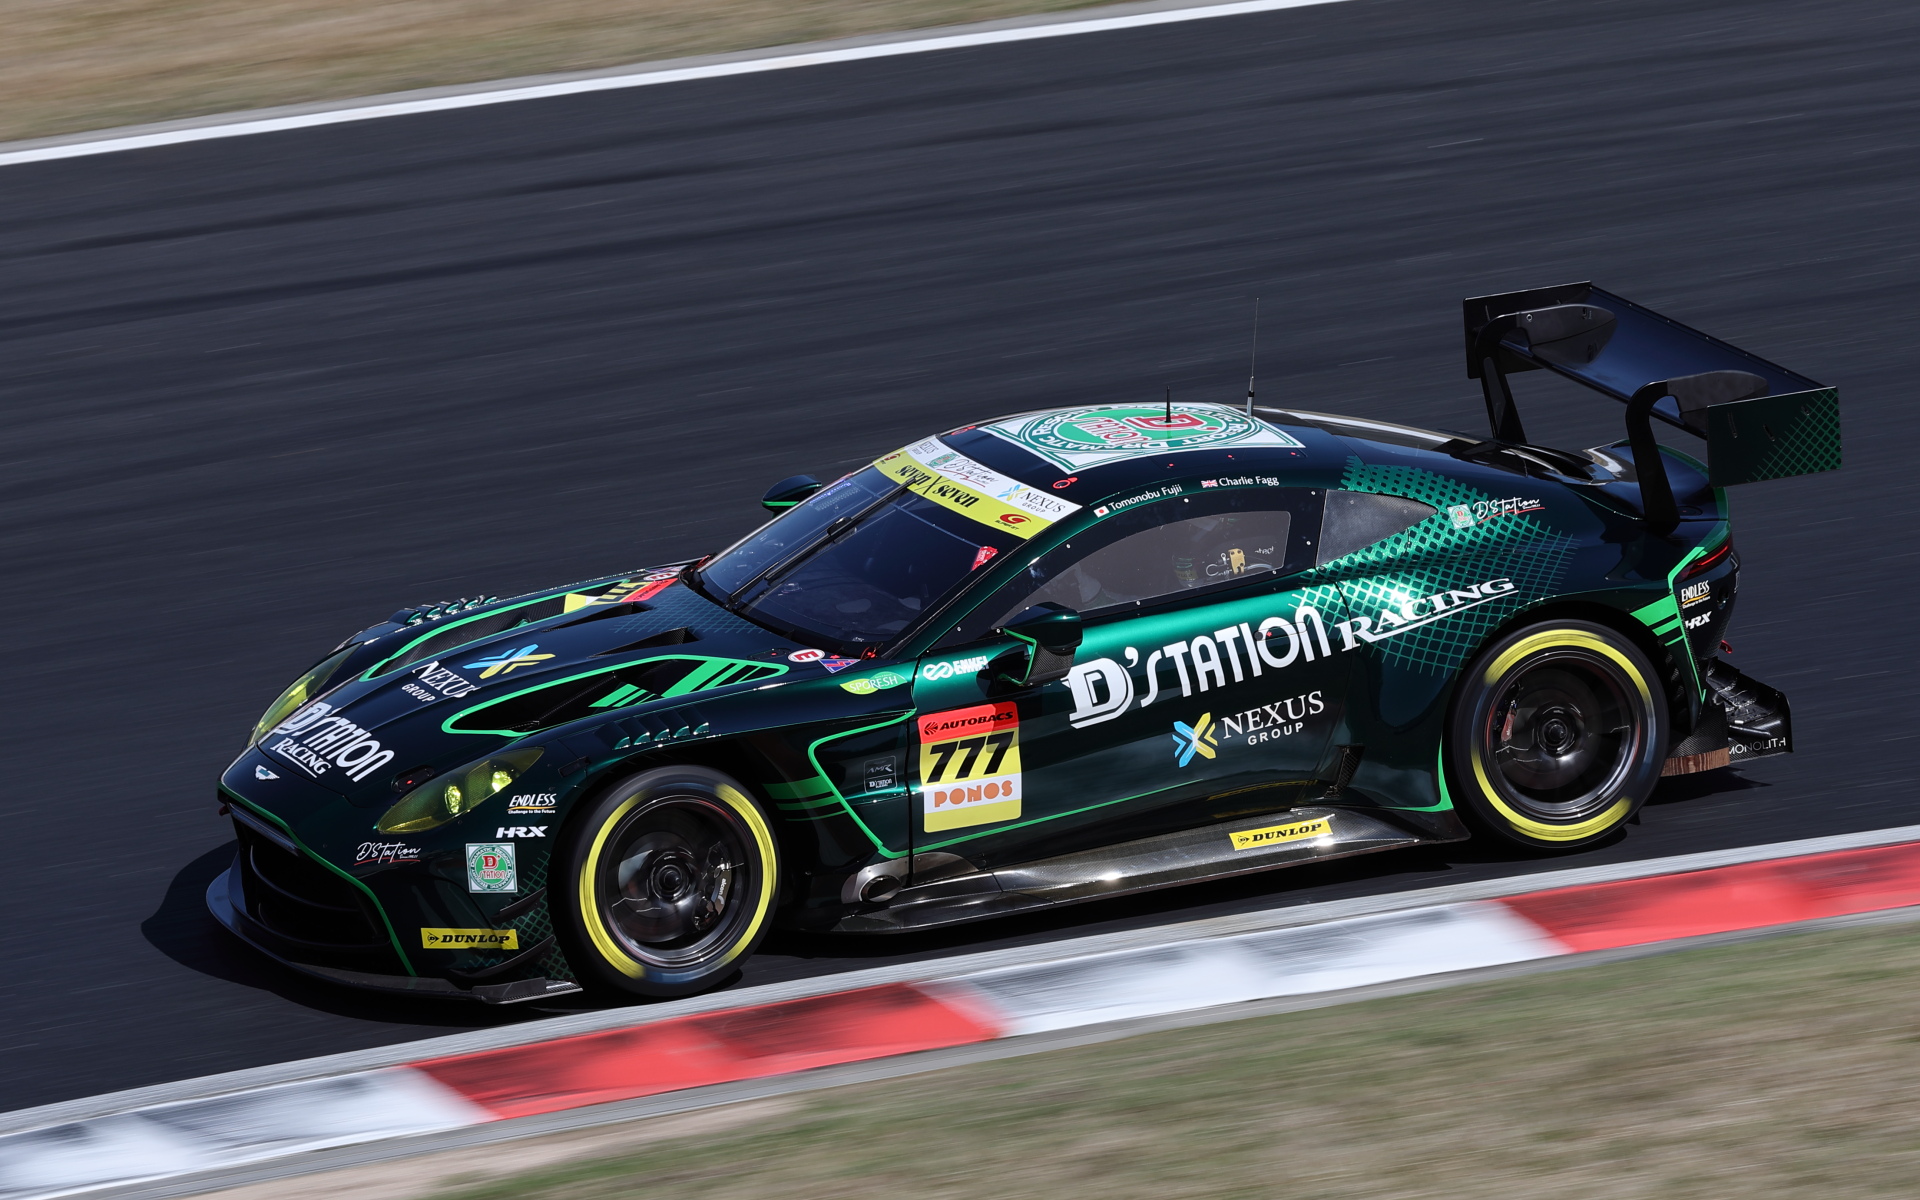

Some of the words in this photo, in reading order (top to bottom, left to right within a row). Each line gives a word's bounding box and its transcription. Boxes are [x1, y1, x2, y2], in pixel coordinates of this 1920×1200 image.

[895, 464, 932, 486] seven
[932, 484, 980, 509] seven
[1218, 476, 1254, 488] Charlie
[1255, 475, 1280, 487] Fagg
[1020, 491, 1067, 513] NEXUS
[1021, 502, 1047, 513] GROUP
[1108, 489, 1161, 511] Tomonobu
[1161, 483, 1183, 496] Fujii
[1681, 580, 1710, 602] ENDLESS
[1685, 611, 1712, 630] HRX
[1061, 605, 1333, 730] D'STATION
[1335, 577, 1519, 653] RACING
[411, 660, 481, 699] NEXUS
[849, 675, 899, 693] SPORESH
[401, 683, 436, 702] GROUP
[939, 711, 1014, 731] AUTOBACS
[1222, 690, 1325, 740] NEXUS
[1247, 721, 1304, 746] GROUP
[270, 737, 332, 776] RACING
[926, 731, 1015, 784] 777
[508, 792, 557, 807] ENDLESS
[934, 779, 1013, 808] PONOS
[495, 825, 549, 839] HRX
[1250, 821, 1322, 844] DUNLOP
[478, 870, 507, 879] STATION
[440, 934, 510, 944] DUNLOP
